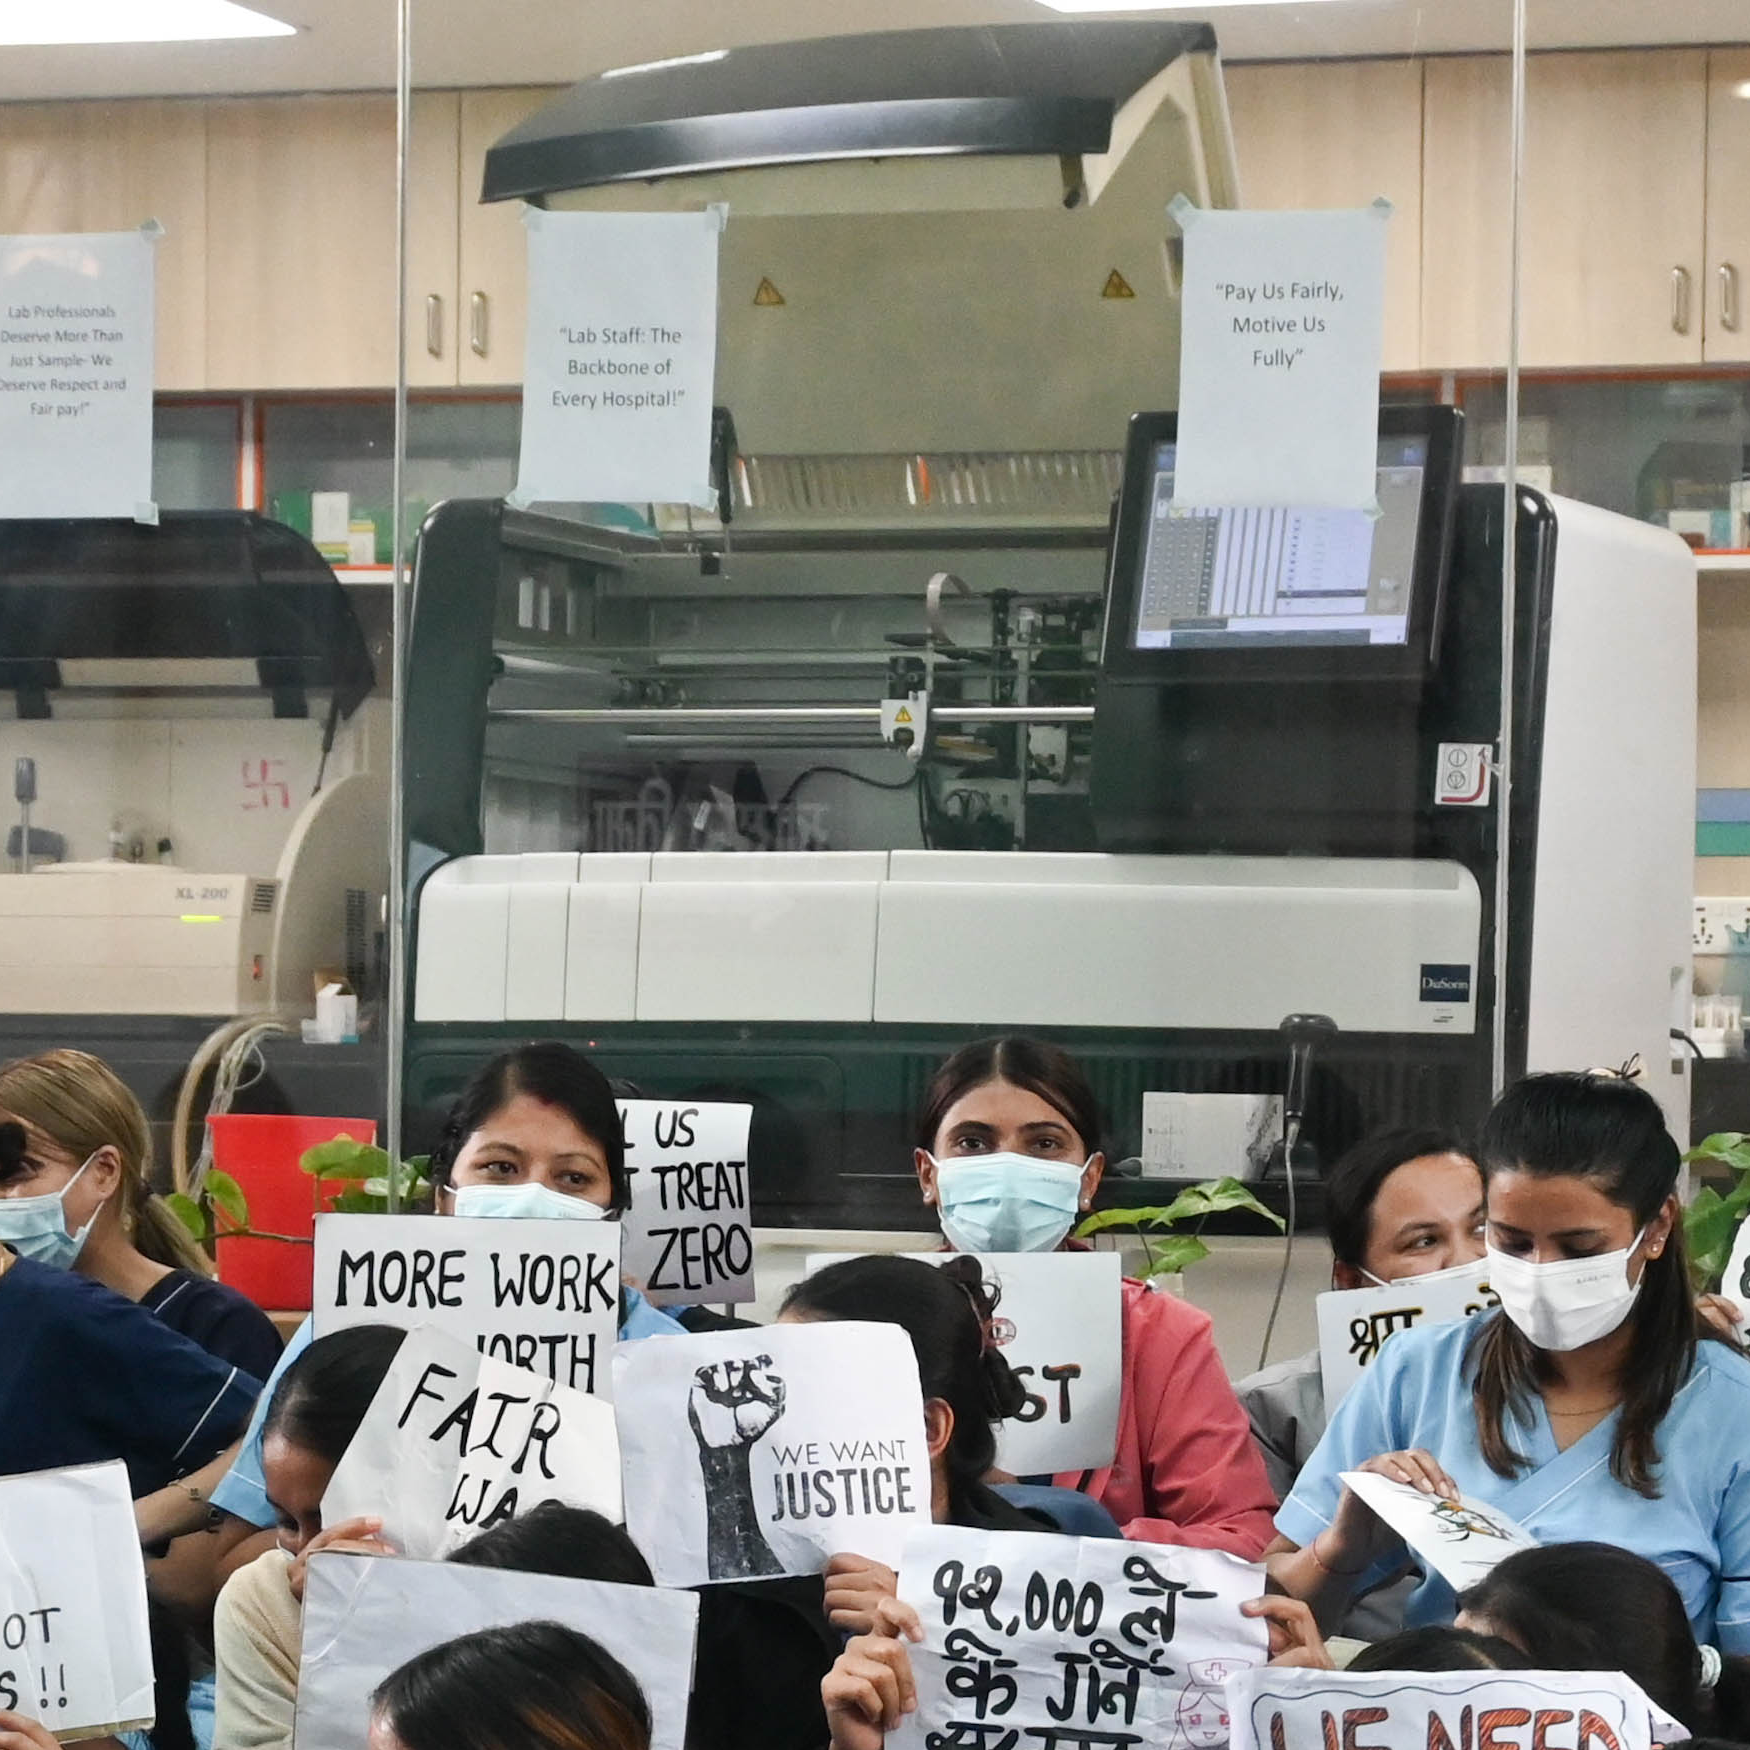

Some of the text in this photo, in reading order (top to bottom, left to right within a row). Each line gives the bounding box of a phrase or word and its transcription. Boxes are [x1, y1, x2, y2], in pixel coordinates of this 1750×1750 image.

[1262, 283, 1285, 299] Us
[1291, 281, 1345, 303] Fairly,
[8, 304, 116, 319] Lab Professionals
[1232, 316, 1326, 334] Motive Us
[1, 330, 123, 343] Deserve More Than
[602, 326, 645, 344] Staff:
[650, 327, 682, 344] The
[10, 354, 33, 368] Just
[91, 354, 113, 367] We
[568, 358, 674, 376] Backbone of
[50, 379, 99, 393] Respect
[102, 378, 126, 391] and
[552, 391, 597, 409] Every
[31, 403, 53, 416] Fair
[655, 1108, 700, 1149] US
[651, 1161, 746, 1211] TREAT
[647, 1223, 752, 1290] ZERO
[334, 1249, 616, 1313] MORE WORK
[397, 1362, 561, 1480] FAIR
[772, 1439, 908, 1467] WE WANT
[771, 1466, 917, 1522] JUSTICE
